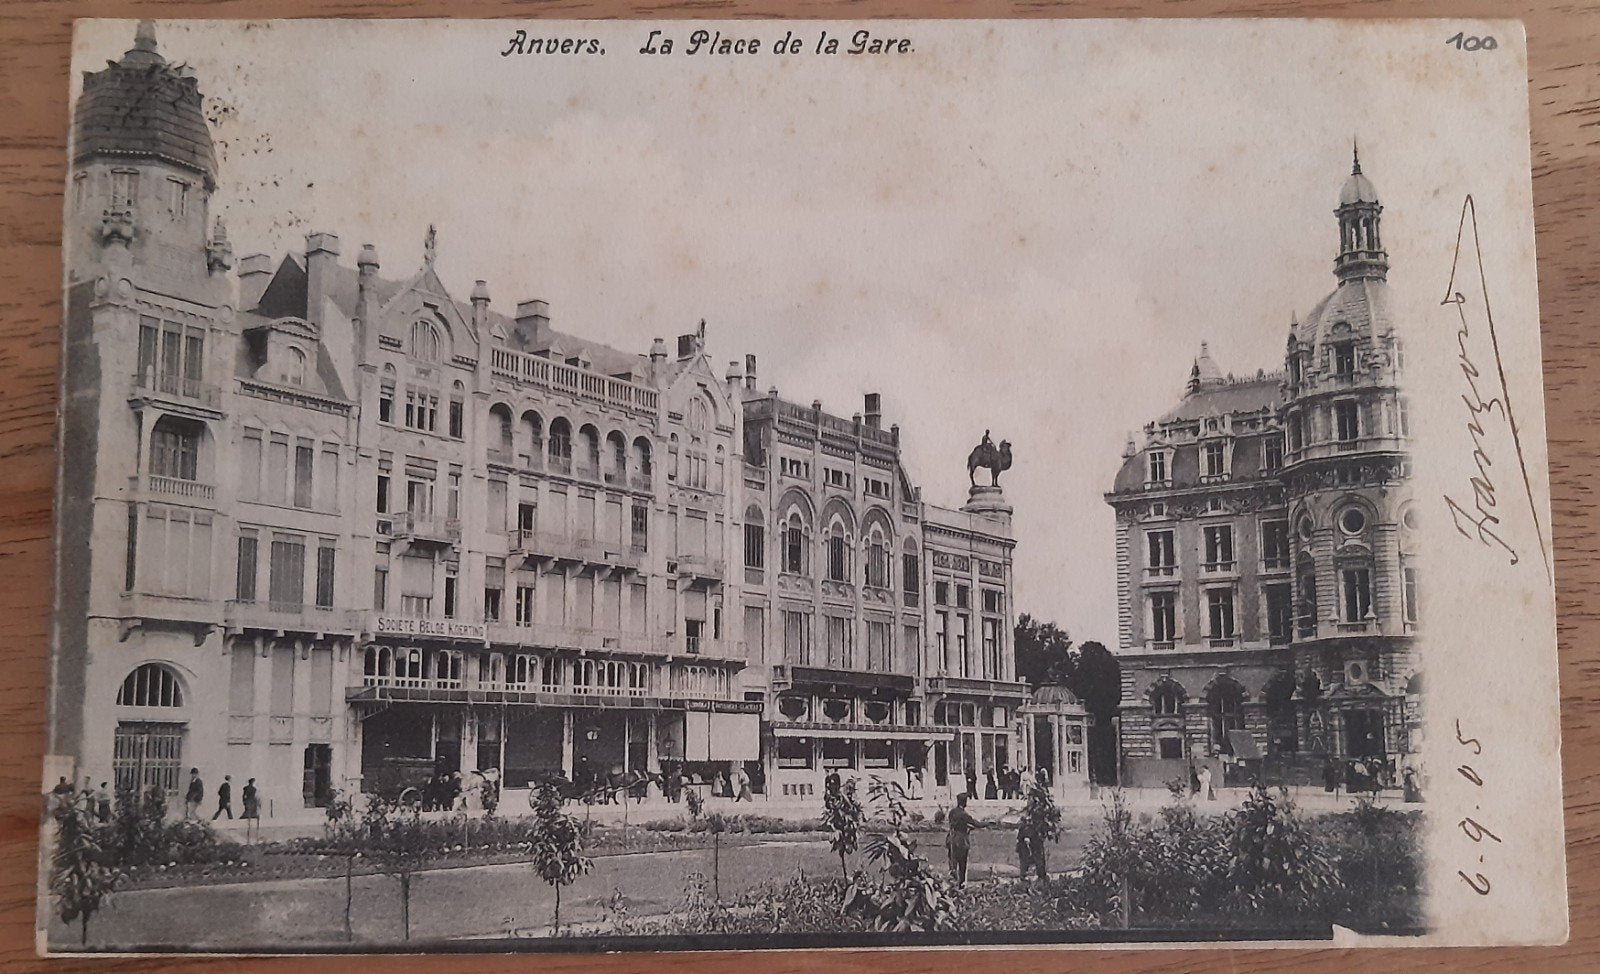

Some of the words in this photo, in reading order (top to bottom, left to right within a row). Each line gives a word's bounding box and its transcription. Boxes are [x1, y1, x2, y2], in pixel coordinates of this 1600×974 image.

[501, 29, 606, 56] Anvers.
[640, 30, 674, 55] La
[686, 30, 761, 55] Place
[773, 31, 803, 55] de
[815, 31, 839, 55] la
[847, 30, 916, 55] Gare.
[1445, 31, 1498, 52] 100
